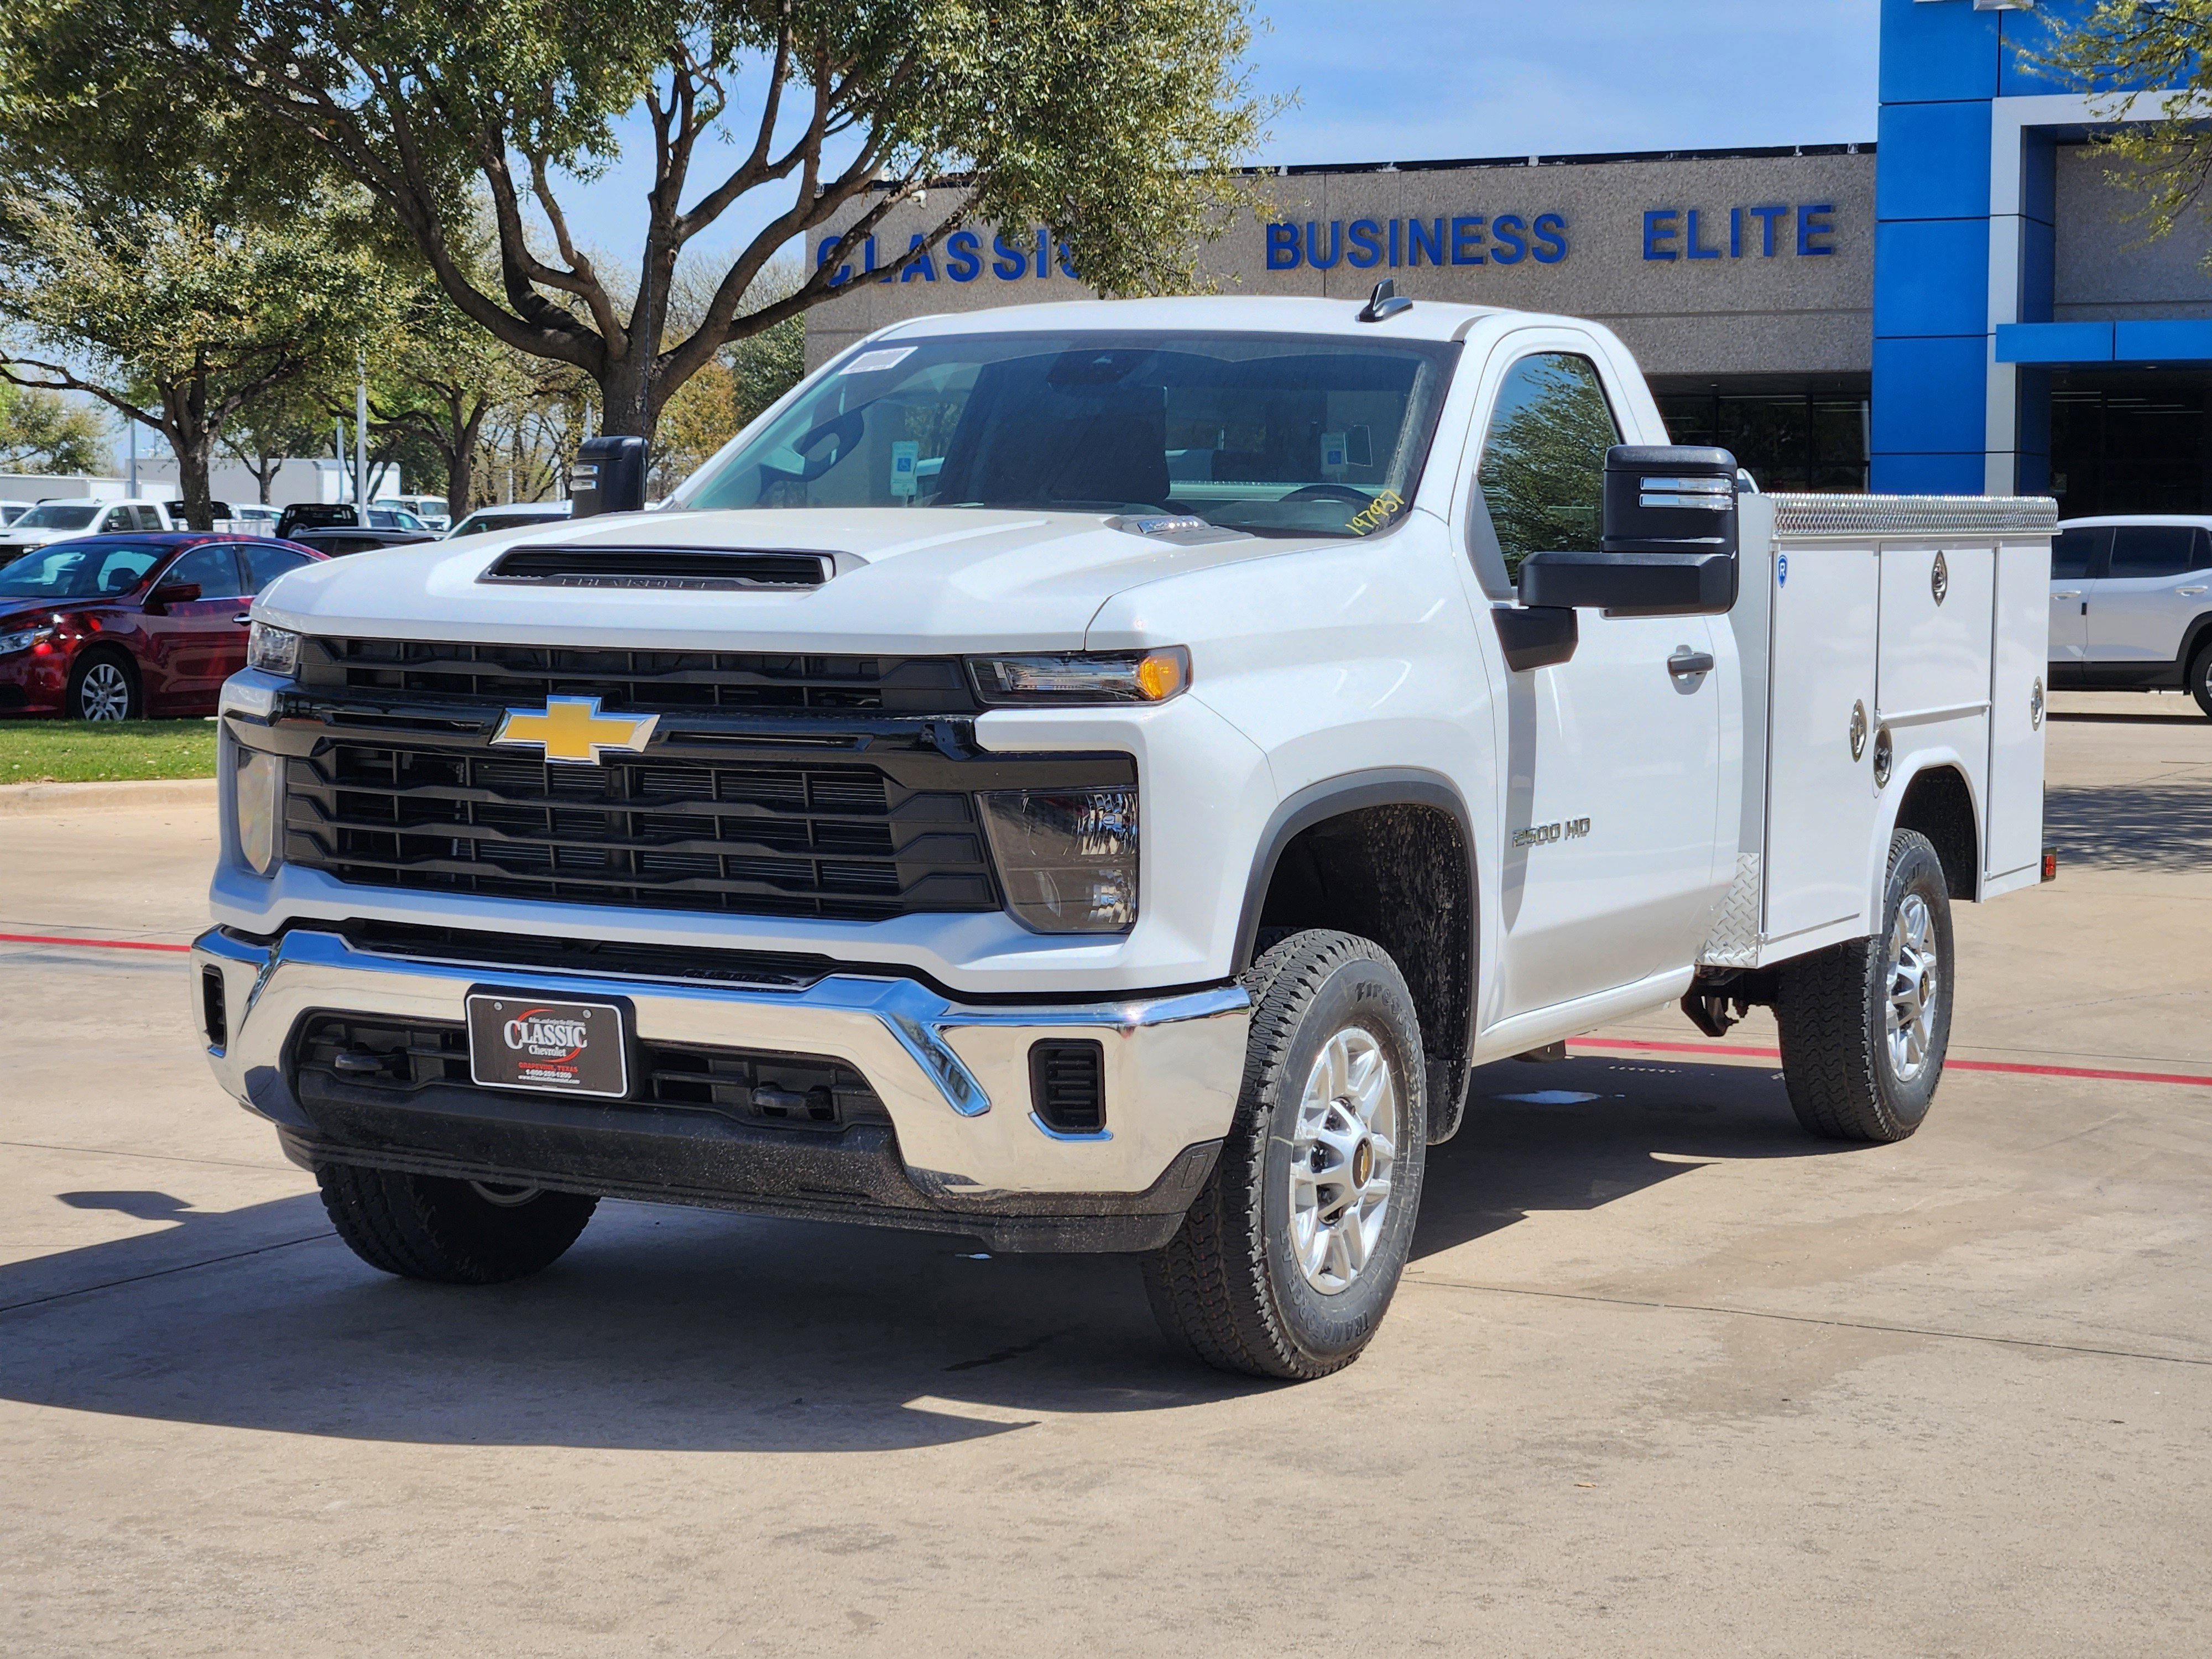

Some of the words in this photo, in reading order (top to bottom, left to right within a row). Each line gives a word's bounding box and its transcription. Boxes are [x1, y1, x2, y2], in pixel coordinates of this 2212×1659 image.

[1265, 213, 1569, 271] BUSINESS
[1642, 204, 1834, 262] ELITE
[1512, 823, 1561, 848] 2500
[1564, 817, 1590, 841] HD
[504, 1020, 588, 1050] CLASSIC
[528, 1045, 567, 1057] Chevrolet
